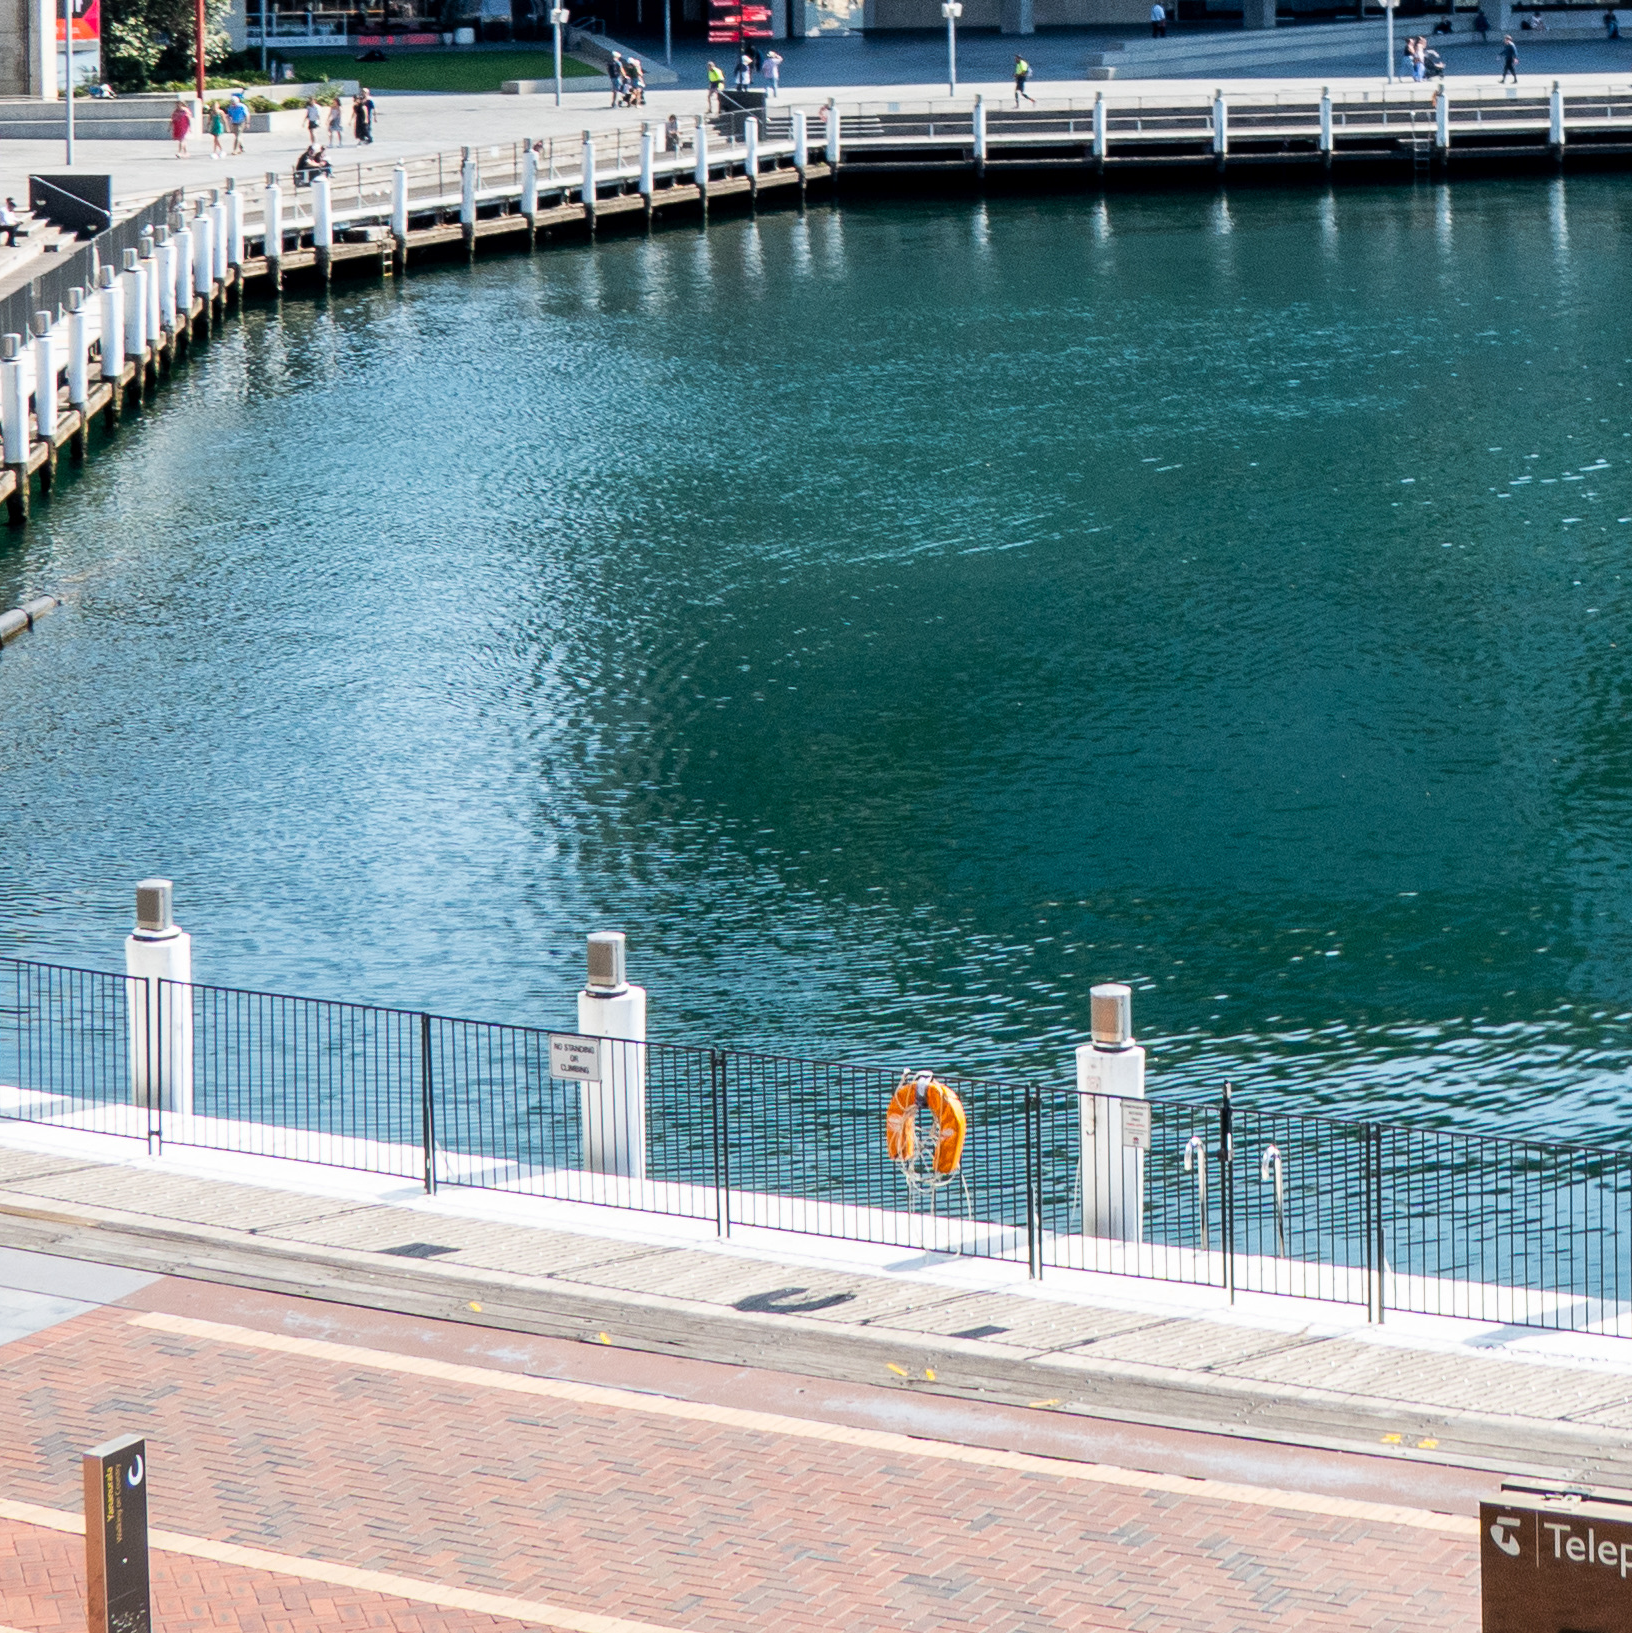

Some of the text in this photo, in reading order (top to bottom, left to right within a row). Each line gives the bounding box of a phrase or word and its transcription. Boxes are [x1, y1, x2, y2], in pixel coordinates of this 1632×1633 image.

[553, 1042, 595, 1054] NO STANDING
[569, 1054, 579, 1063] OR
[560, 1063, 590, 1074] CLIMBING
